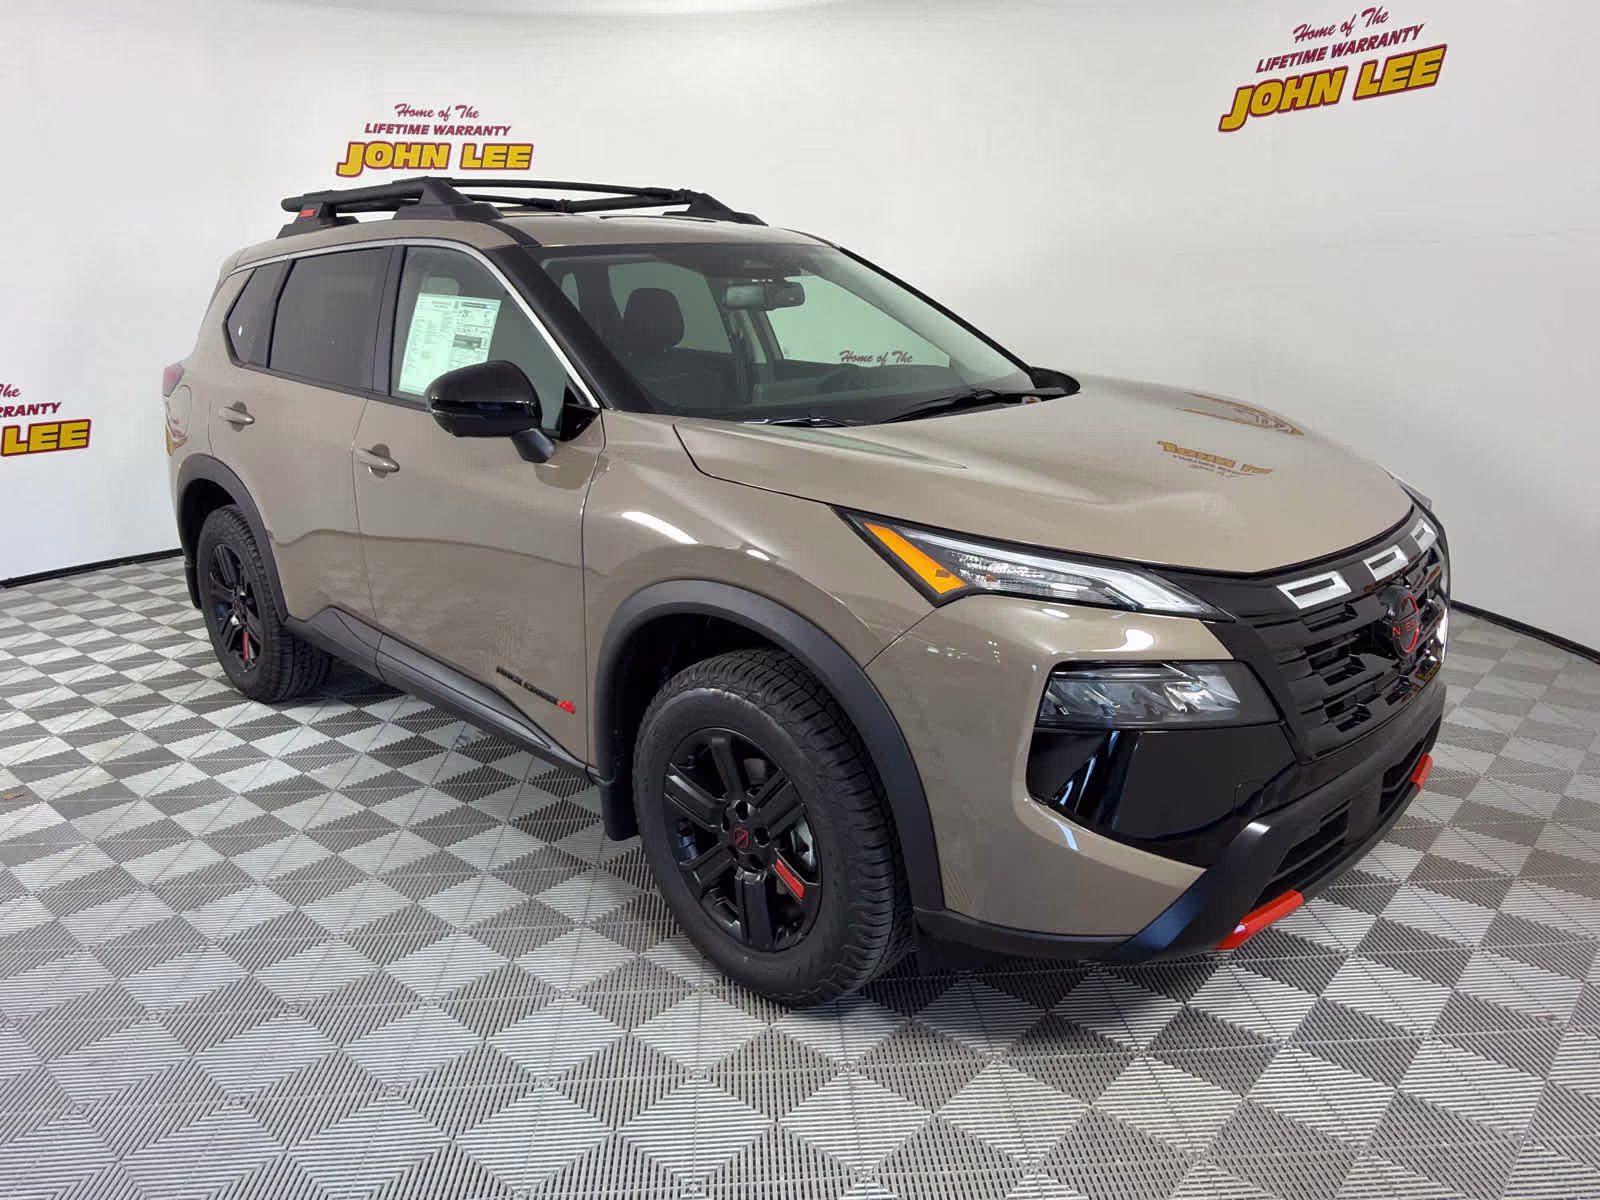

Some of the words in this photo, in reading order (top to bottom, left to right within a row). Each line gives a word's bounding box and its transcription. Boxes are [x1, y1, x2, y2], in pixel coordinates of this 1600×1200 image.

[1293, 24, 1336, 44] Home
[1340, 14, 1357, 38] of
[1361, 6, 1389, 28] The
[1256, 46, 1328, 73] LIFETIME
[1330, 24, 1424, 58] WARRANTY
[1218, 66, 1349, 132] JOHN
[1352, 44, 1448, 100] LEE
[364, 123, 430, 135] LIFETIME
[433, 124, 511, 136] WARRANTY
[394, 103, 434, 119] Home
[438, 105, 452, 121] of
[455, 104, 480, 119] The
[336, 141, 451, 177] JOHN
[459, 143, 534, 170] LEE
[840, 349, 874, 363] Home
[876, 352, 889, 368] of
[892, 350, 913, 363] The
[0, 418, 91, 457] LEE
